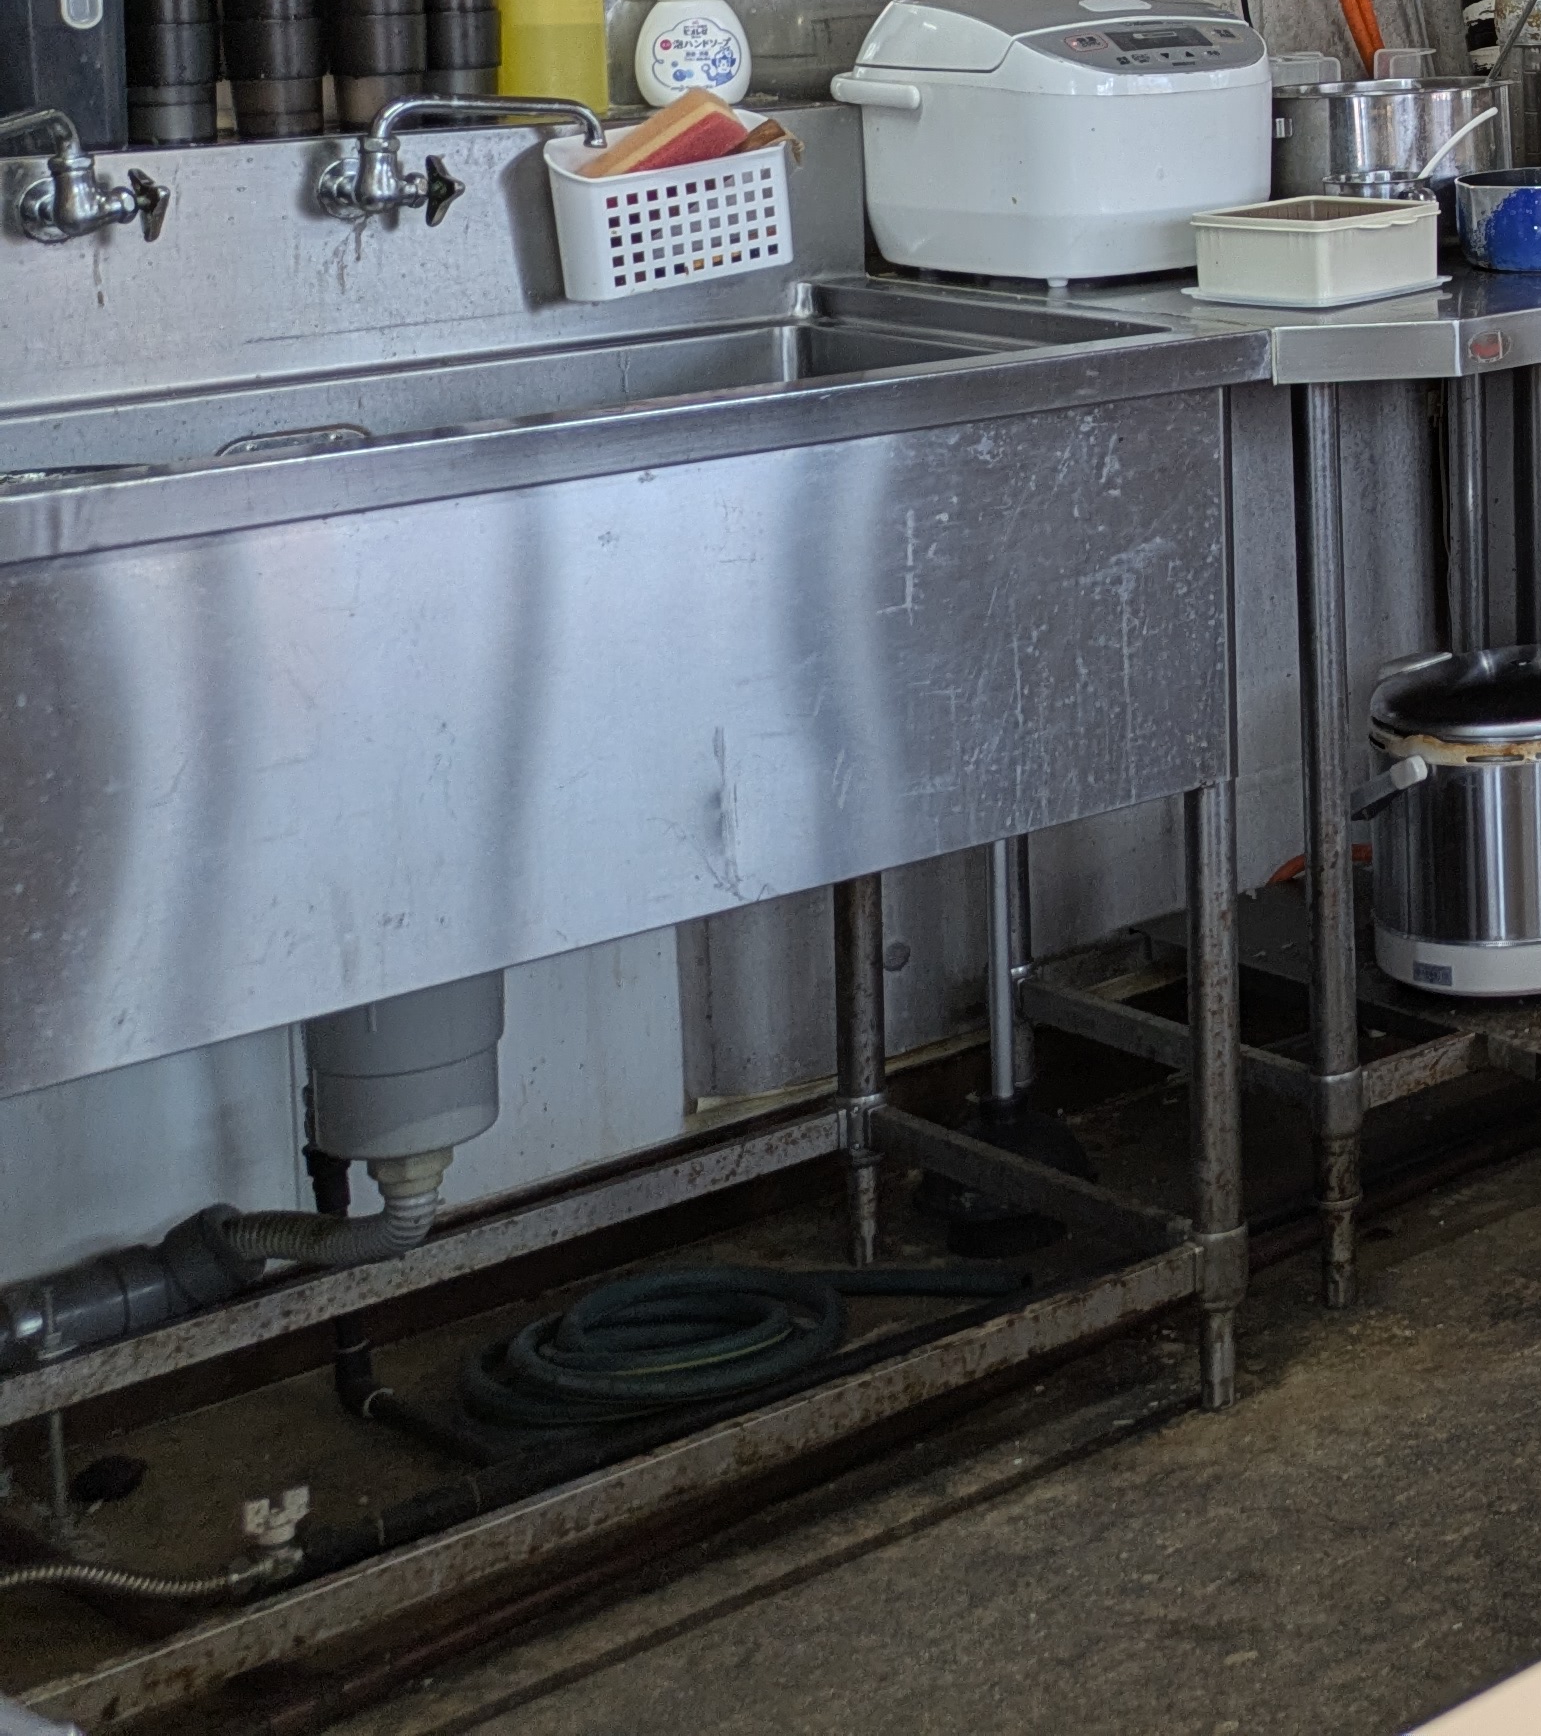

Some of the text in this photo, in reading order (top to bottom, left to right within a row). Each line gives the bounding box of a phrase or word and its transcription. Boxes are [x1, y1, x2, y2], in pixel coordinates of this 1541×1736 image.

[672, 37, 732, 49] 泡ハンドソープ
